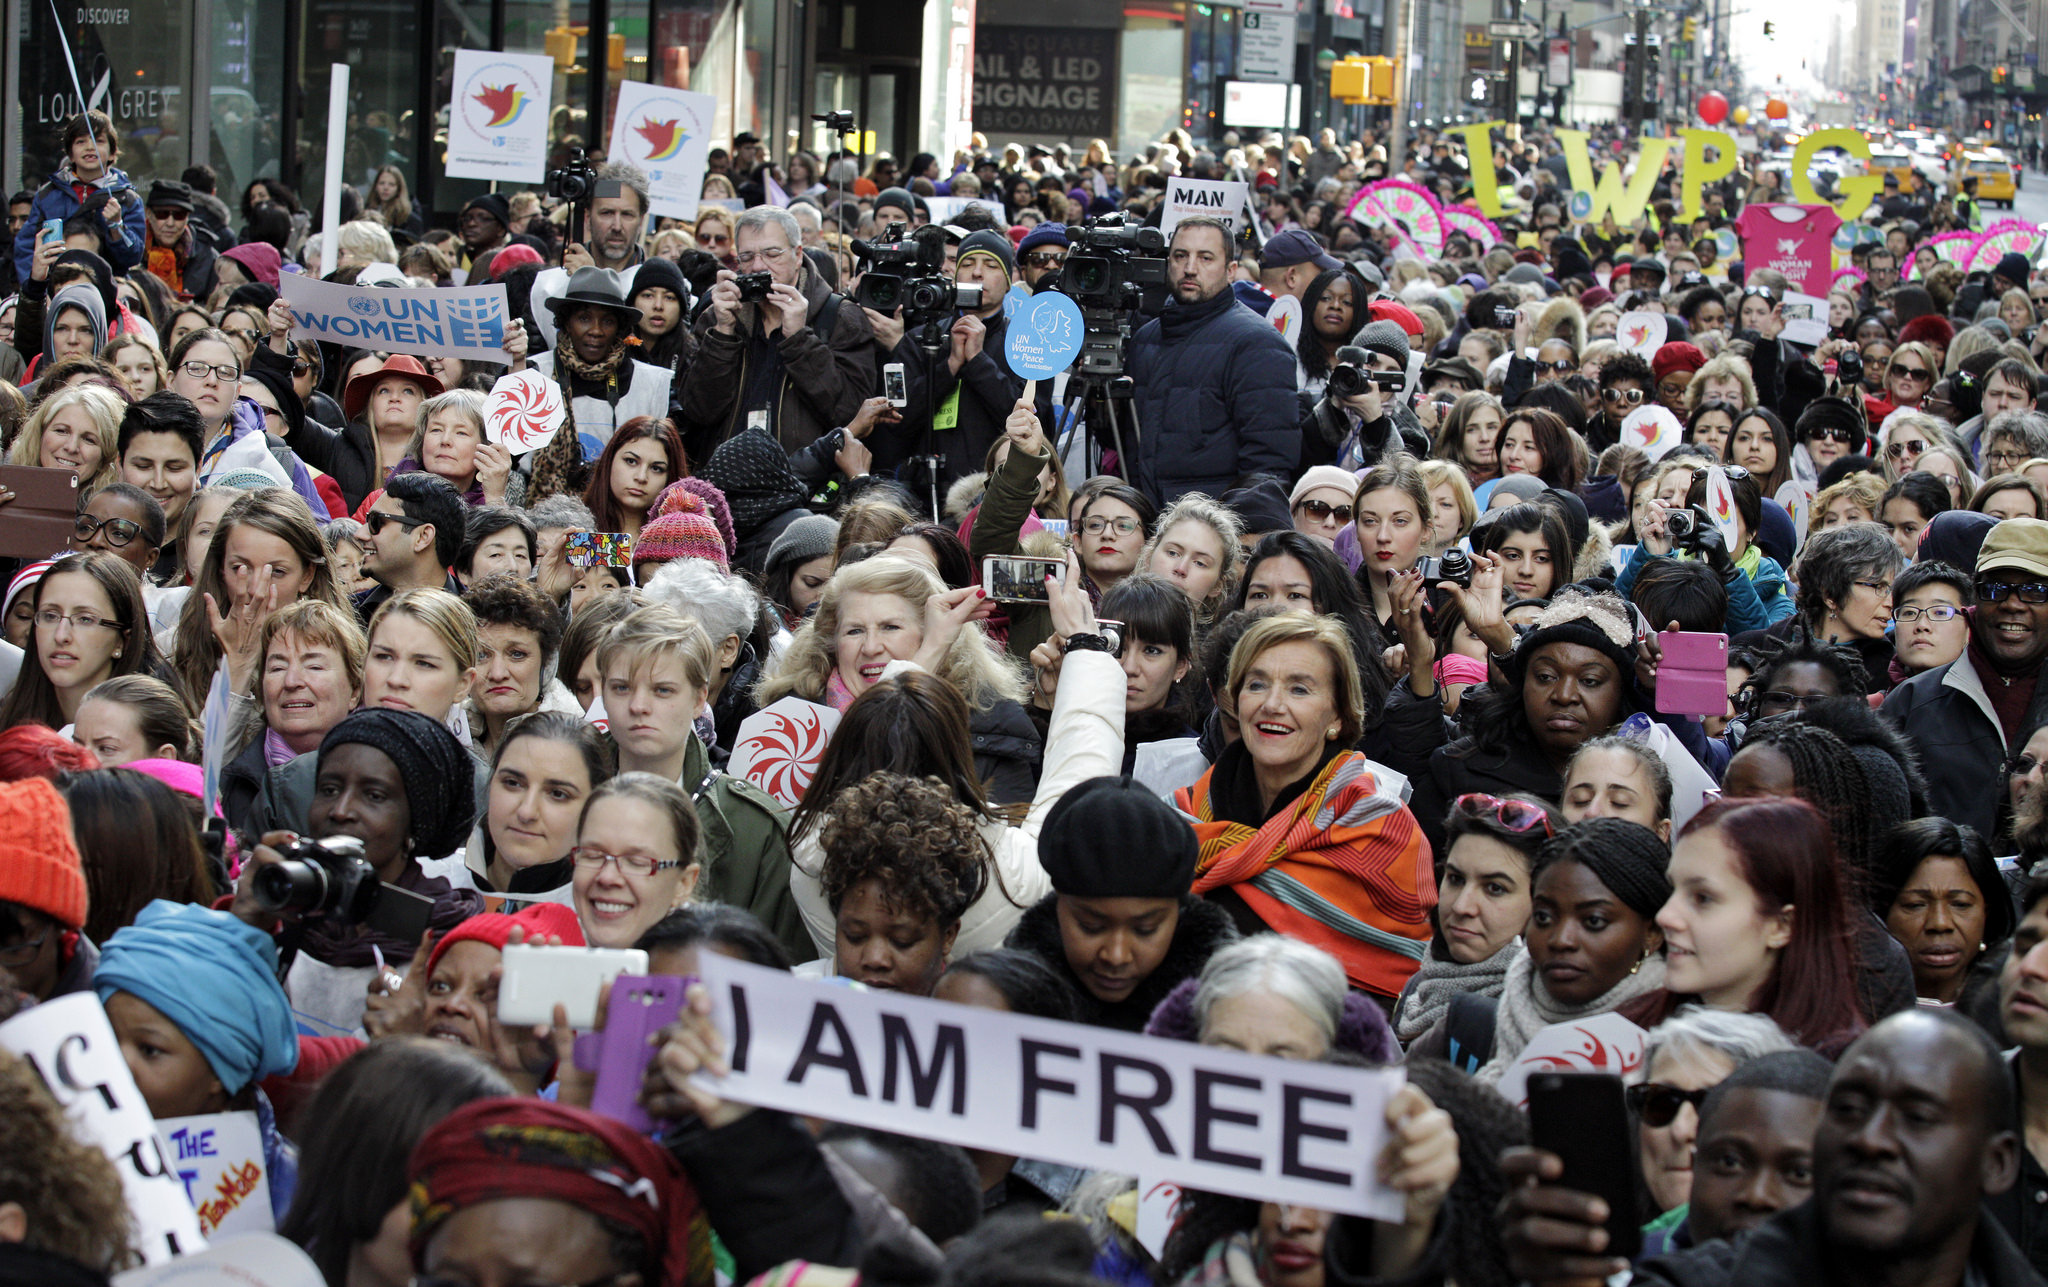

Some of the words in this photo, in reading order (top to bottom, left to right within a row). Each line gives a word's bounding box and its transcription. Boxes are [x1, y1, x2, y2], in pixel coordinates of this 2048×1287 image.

[77, 8, 130, 24] DISCOVER
[1246, 13, 1258, 28] 6
[974, 54, 1011, 78] AIL
[1019, 55, 1042, 80] &
[1052, 57, 1101, 81] LED
[120, 89, 171, 119] GREY
[972, 82, 1101, 110] SIGNAGE
[982, 111, 1101, 132] BROADWAY
[1173, 187, 1225, 207] MAN
[382, 297, 440, 322] UN
[290, 309, 445, 346] WOMEN
[1015, 334, 1030, 344] UN
[1011, 343, 1044, 355] Women
[1021, 353, 1045, 363] Peace
[730, 984, 750, 1072] I
[787, 1001, 966, 1115] AM
[1020, 1037, 1354, 1186] FREE
[170, 1126, 218, 1160] THE
